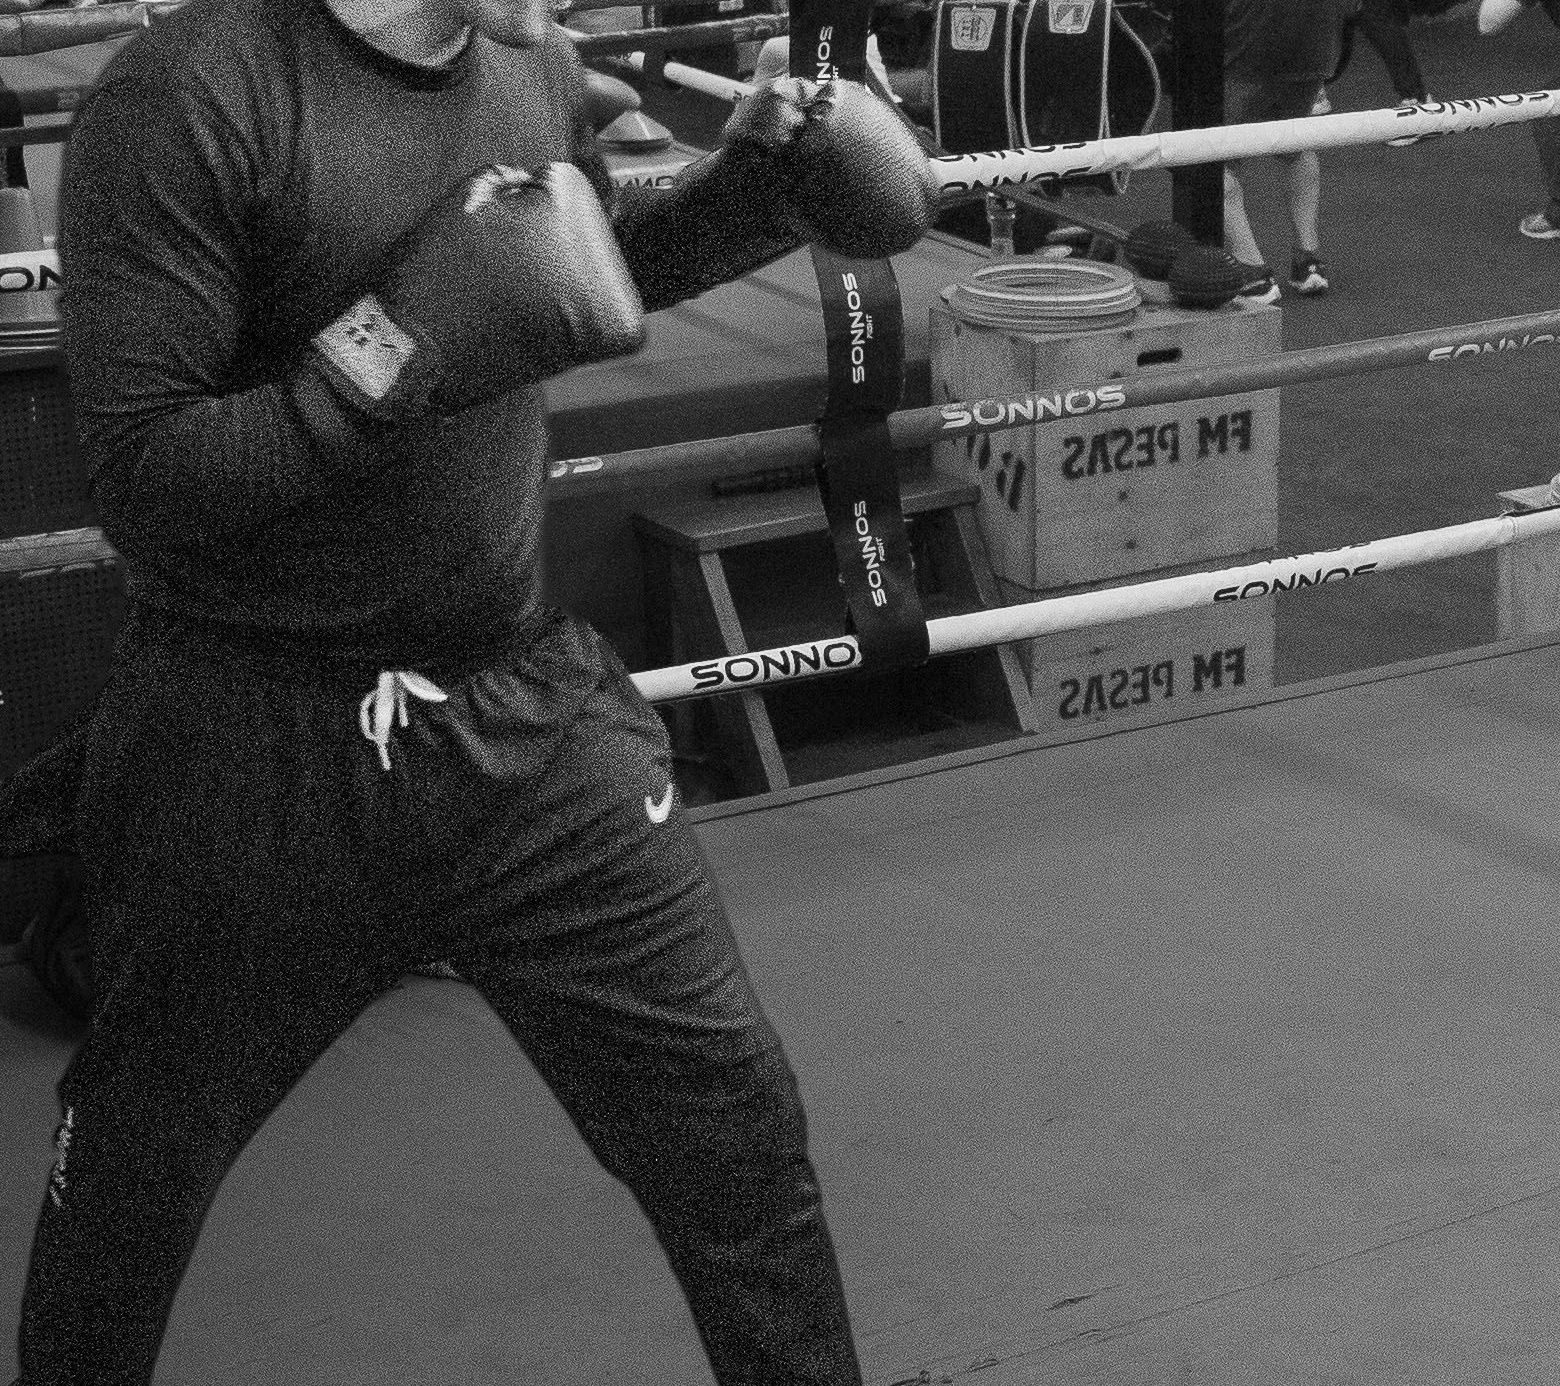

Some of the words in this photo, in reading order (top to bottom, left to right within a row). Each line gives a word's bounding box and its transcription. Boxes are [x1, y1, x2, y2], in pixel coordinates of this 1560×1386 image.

[842, 272, 866, 384] SONNOS
[941, 384, 1127, 430] SONNOS
[853, 499, 888, 608] SONNOS
[689, 641, 859, 691] SONNO
